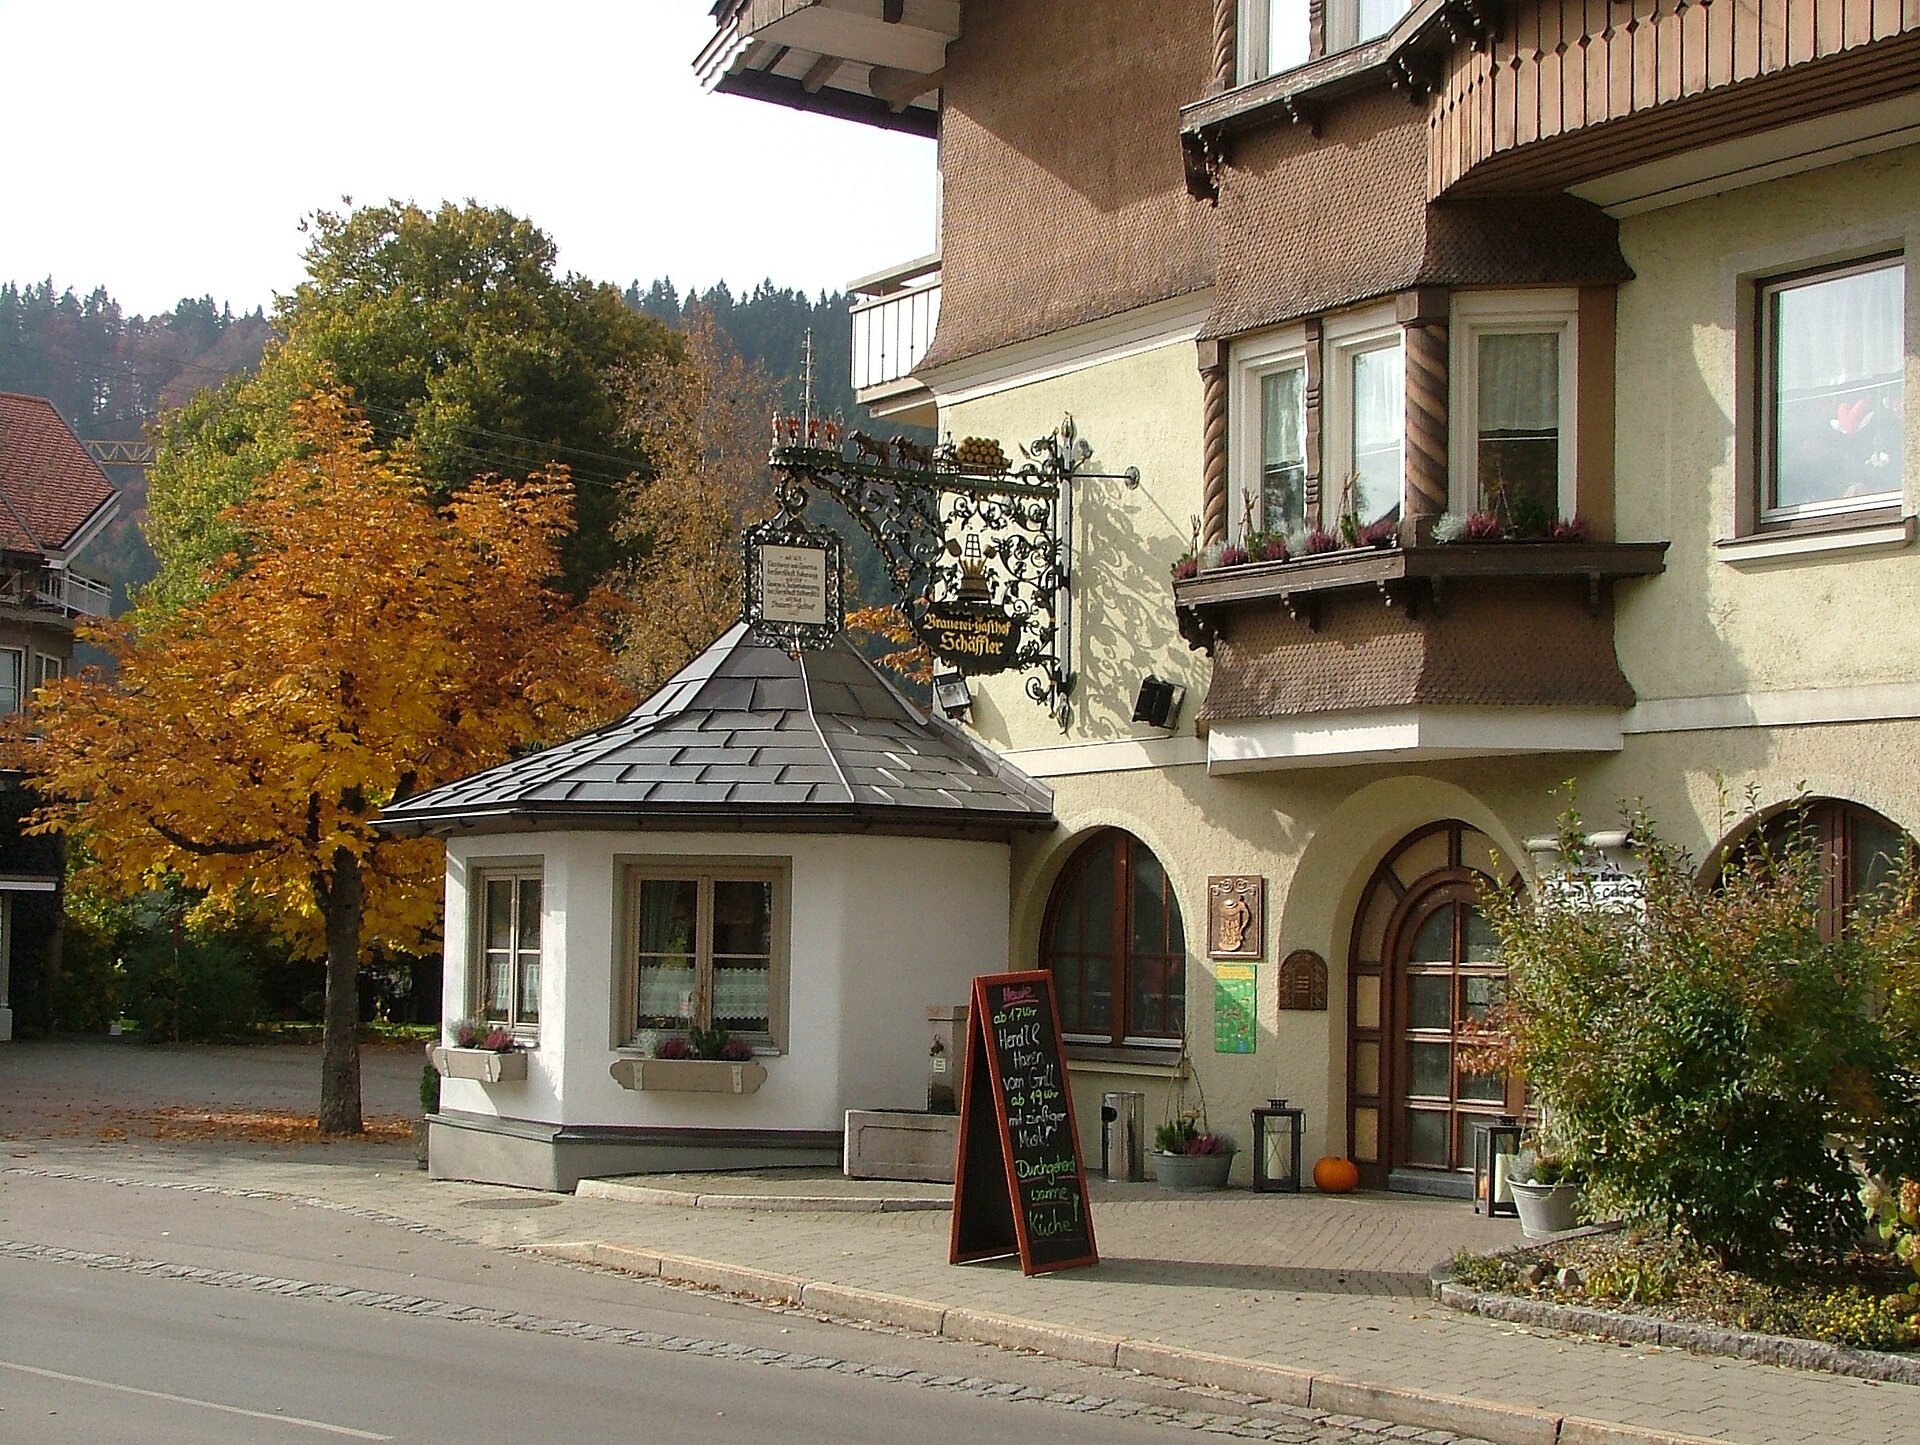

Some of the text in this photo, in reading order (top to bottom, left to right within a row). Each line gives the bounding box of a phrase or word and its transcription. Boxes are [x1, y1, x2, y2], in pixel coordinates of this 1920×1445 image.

[939, 631, 1004, 656] Schäffler
[993, 1011, 1007, 1024] ab
[1008, 1007, 1022, 1021] 17
[1002, 1063, 1056, 1092] vom Grill
[1011, 1091, 1025, 1106] ab
[1030, 1089, 1043, 1105] 19
[1008, 1108, 1023, 1127] mit
[1031, 1187, 1068, 1201] warme
